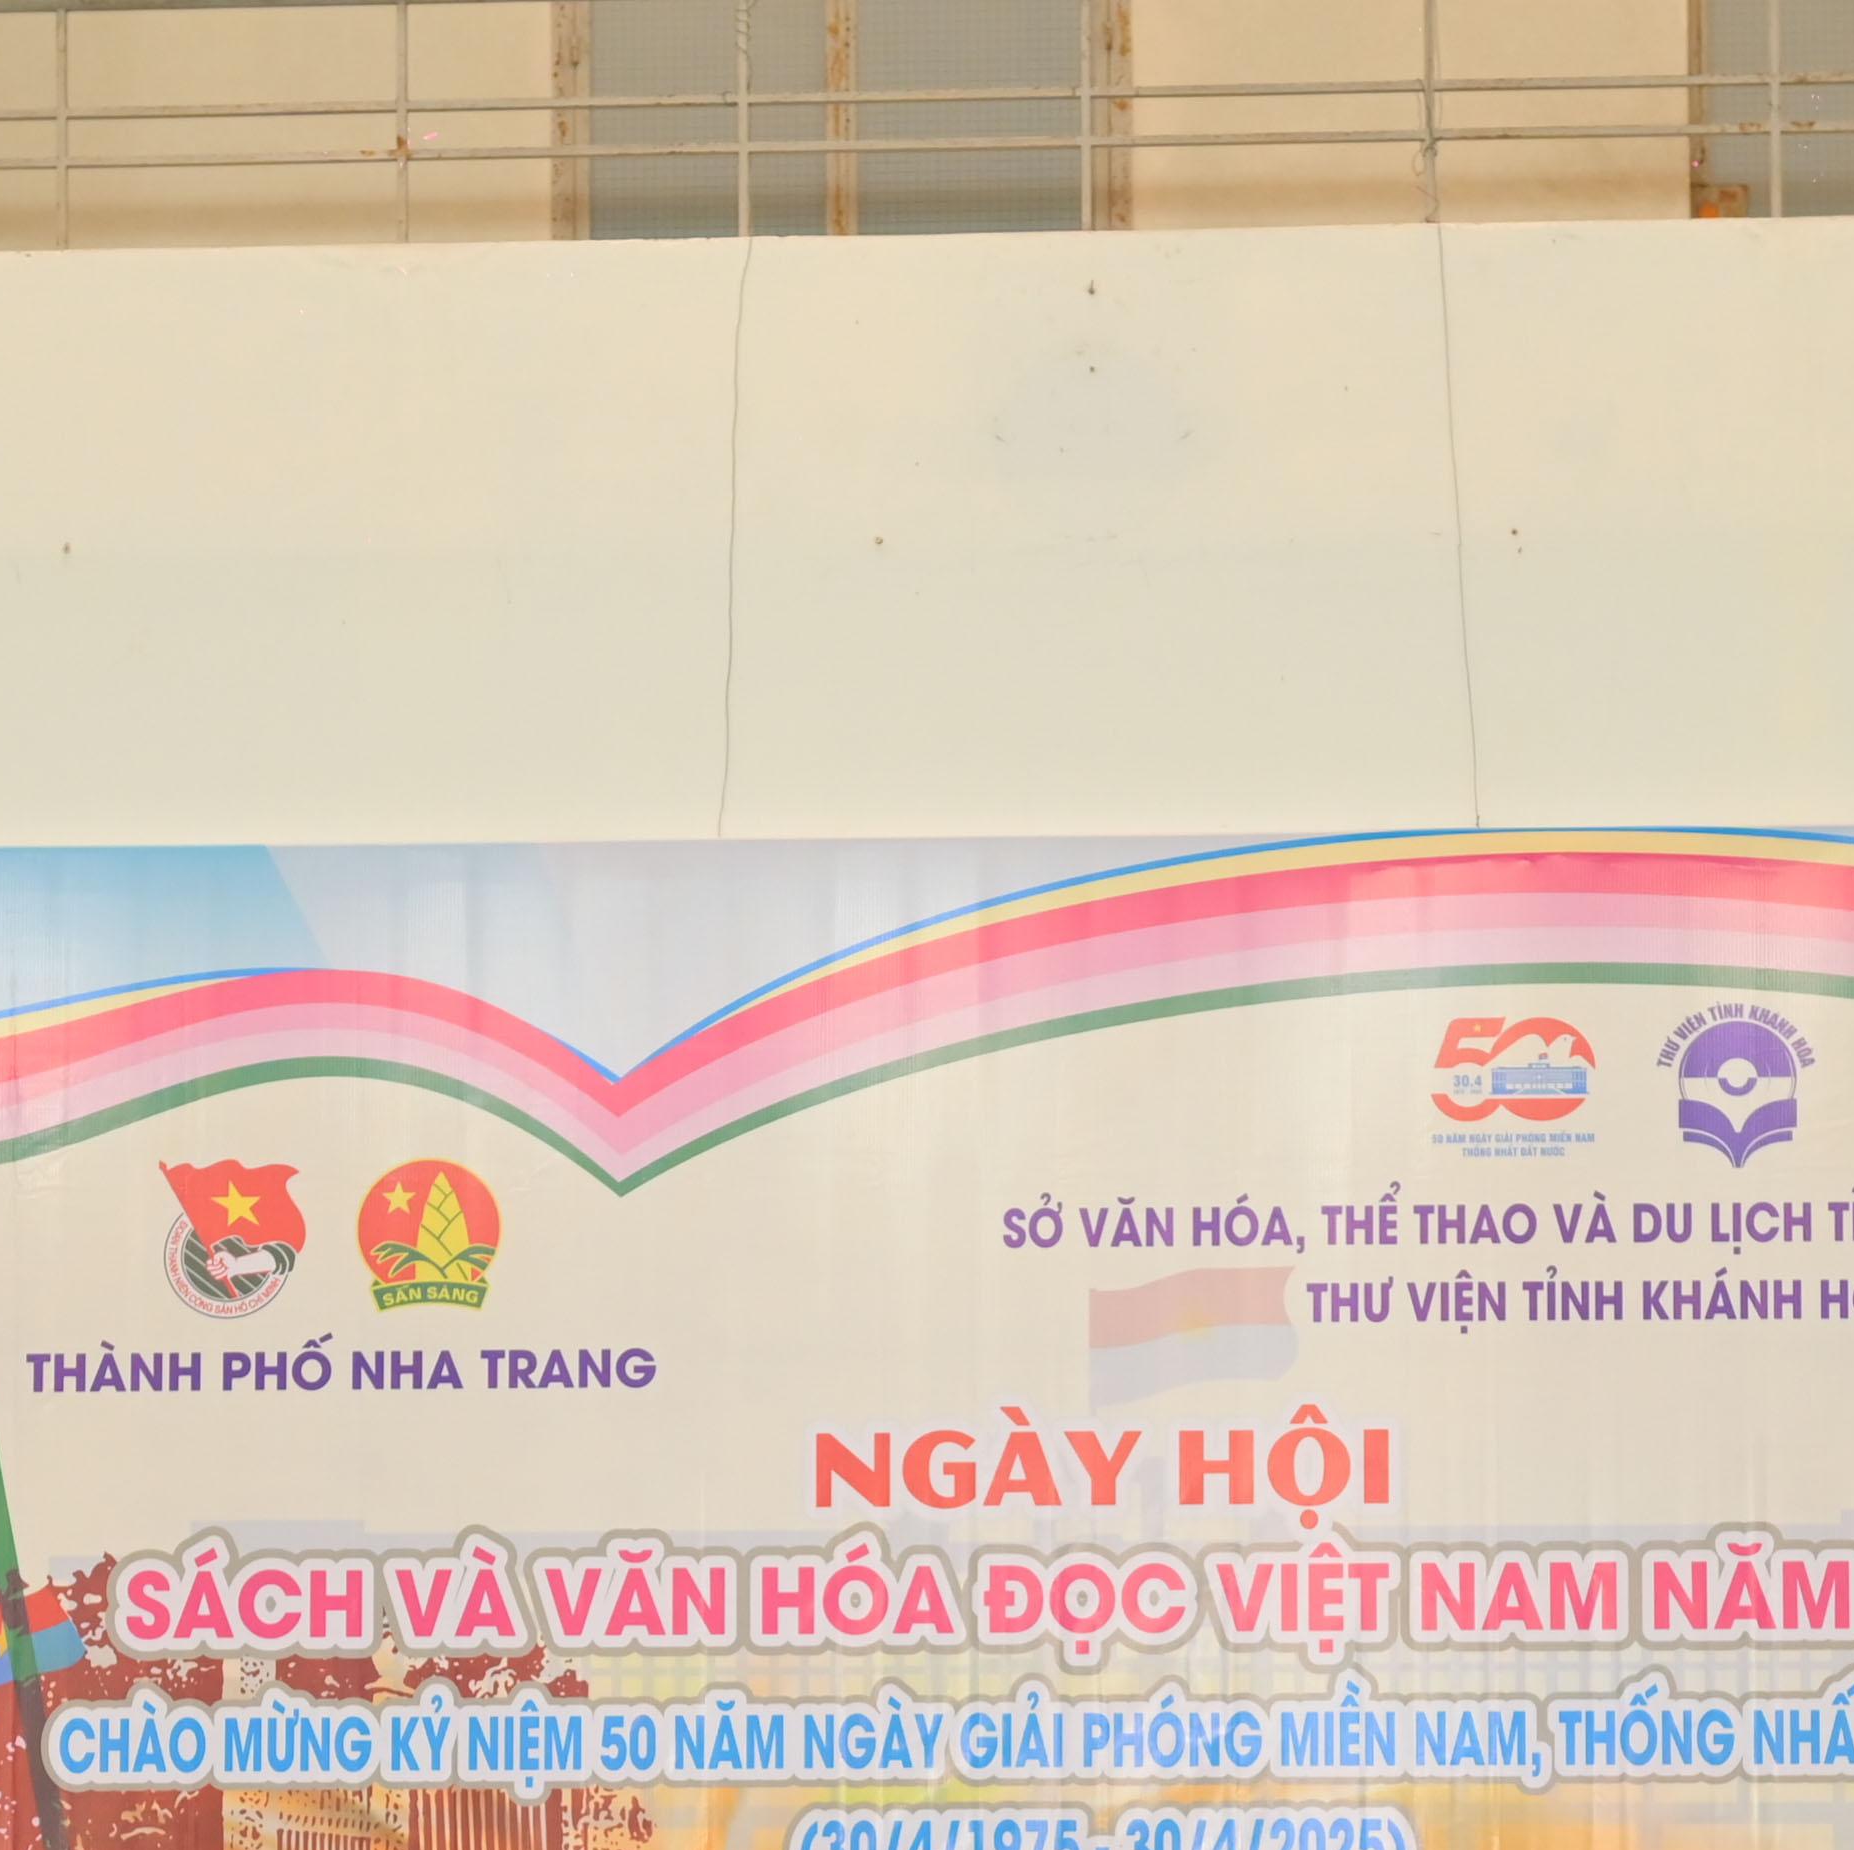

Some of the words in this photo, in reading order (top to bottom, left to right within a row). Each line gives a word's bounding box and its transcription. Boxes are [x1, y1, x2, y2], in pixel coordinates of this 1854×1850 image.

[1003, 1193, 1063, 1248] SỞ
[1079, 1197, 1174, 1247] VĂN
[1193, 1194, 1305, 1253] HÓA,
[1322, 1182, 1399, 1245] THỂ
[1414, 1204, 1537, 1244] THAO
[1554, 1191, 1617, 1243] VÀ
[1633, 1203, 1692, 1243] DU
[1711, 1202, 1812, 1254] LỊCH
[1306, 1277, 1392, 1322] THƯ
[1407, 1270, 1507, 1333] VIỆN
[1523, 1266, 1623, 1321] TỈNH
[1643, 1268, 1801, 1320] KHÁNH
[26, 1340, 202, 1392] THÀNH
[222, 1333, 333, 1391] PHỐ
[351, 1350, 463, 1389] NHA
[481, 1347, 656, 1389] TRANG
[815, 1406, 1142, 1508] NGÀY
[1177, 1405, 1390, 1530] HỘI
[126, 1548, 364, 1640] SÁCH
[396, 1546, 516, 1637] VÀ
[545, 1549, 727, 1636] VĂN
[761, 1545, 957, 1636] HÓA
[983, 1562, 1187, 1655] ĐỌC
[1216, 1543, 1391, 1655] VIỆT
[1419, 1560, 1618, 1632] NAM
[1651, 1542, 1851, 1632] NĂM
[58, 1701, 207, 1774] CHÀO
[223, 1700, 373, 1773] MỪNG
[390, 1697, 453, 1773] KỶ
[466, 1702, 584, 1790] NIỆM
[599, 1715, 657, 1771] 50
[673, 1700, 784, 1770] NĂM
[801, 1697, 941, 1769] NGÀY
[959, 1692, 1065, 1768] GIẢI
[1081, 1696, 1264, 1768] PHÓNG
[1281, 1680, 1397, 1766] MIỀN
[1415, 1712, 1541, 1778] NAM,
[1559, 1685, 1734, 1766] THỐNG
